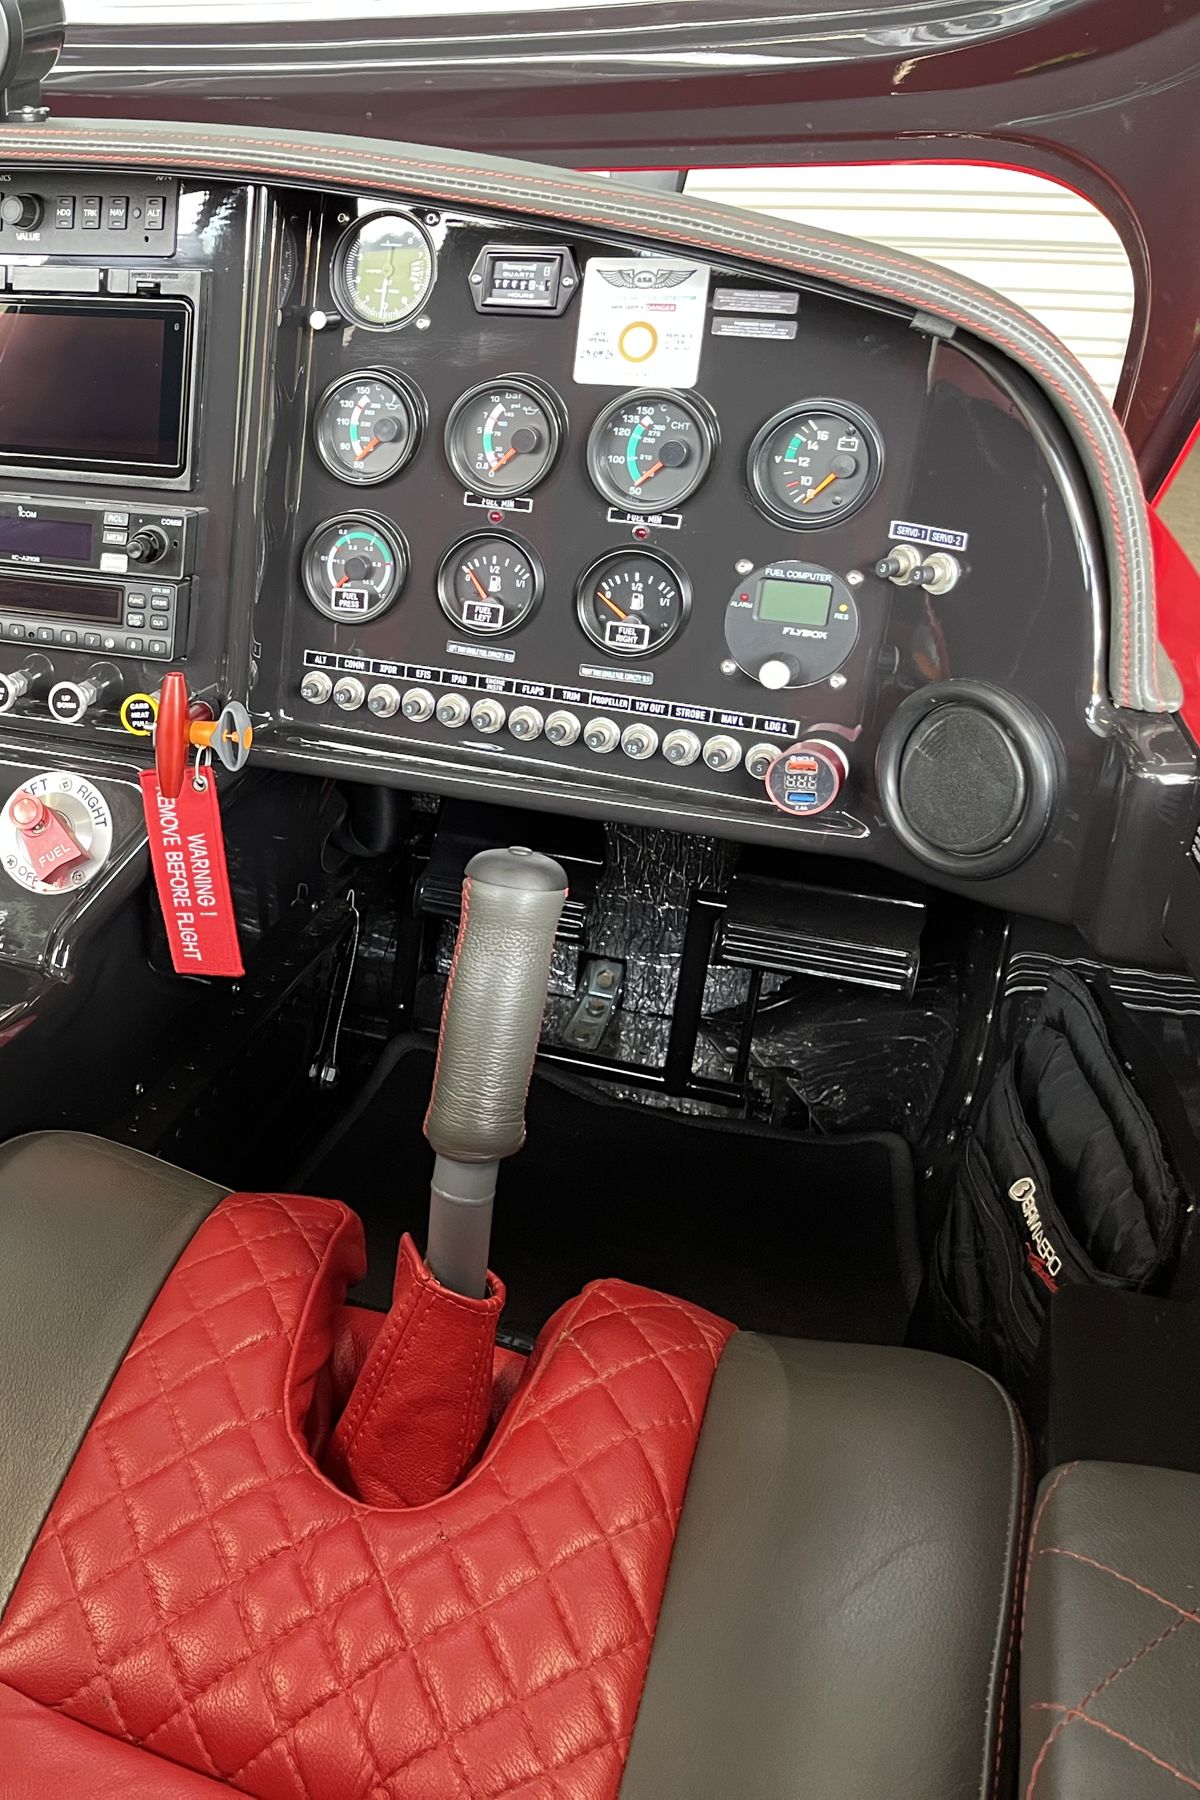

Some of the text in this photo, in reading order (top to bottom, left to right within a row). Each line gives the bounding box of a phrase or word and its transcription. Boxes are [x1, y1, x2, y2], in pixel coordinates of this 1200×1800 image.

[56, 208, 71, 217] HDG
[83, 208, 97, 217] TRK
[109, 208, 125, 217] NAV
[147, 208, 160, 217] ALT
[16, 233, 41, 242] VALUE
[356, 386, 371, 395] 150
[340, 399, 355, 408] 130
[490, 395, 500, 403] 10
[636, 406, 655, 416] 150
[336, 417, 350, 426] 110
[622, 415, 640, 423] 135
[671, 421, 691, 430] CHT
[613, 427, 631, 436] 120
[817, 430, 829, 440] 16
[340, 443, 351, 451] 90
[807, 441, 819, 451] 14
[607, 455, 625, 464] 100
[798, 457, 811, 467] 12
[476, 462, 489, 470] 0.8
[800, 476, 812, 486] 10
[629, 486, 642, 495] 50
[482, 498, 515, 508] FUEL MIN
[108, 514, 123, 523] RCL
[161, 518, 183, 527] COMM
[626, 513, 663, 524] FUEL MIN
[106, 533, 124, 542] MEM
[896, 526, 926, 540] SERVO-1
[931, 532, 961, 546] SERVO-2
[490, 565, 500, 574] 1/2
[765, 567, 832, 582] FUEL COMPUTER
[631, 582, 643, 591] 1/2
[342, 592, 358, 601] FUEL
[339, 600, 360, 608] PRESS
[730, 601, 753, 609] ALARM
[474, 606, 491, 615] FUEL
[474, 614, 492, 623] LEFT
[618, 627, 636, 636] FUEL
[782, 626, 828, 640] FLYBOX
[616, 634, 639, 644] RIGHT
[315, 655, 327, 665] ALT
[344, 660, 365, 670] COMM
[380, 664, 398, 675] XPDR
[415, 669, 432, 680] EFIS
[451, 674, 468, 685] IPAD
[522, 684, 545, 696] FLAPS
[562, 690, 581, 702] TRIM
[592, 693, 628, 708] PROPELLER
[635, 701, 648, 712] 12V
[650, 703, 666, 714] OUT
[675, 707, 706, 720] STROBE
[721, 713, 739, 725] NAV
[764, 720, 780, 731] LDG
[56, 701, 77, 709] DOWN
[130, 702, 150, 710] CARB
[131, 710, 150, 719] HEAT
[302, 688, 637, 753] 25 10 15
[76, 784, 108, 828] RIGHT
[38, 844, 71, 868] FUEL
[186, 832, 216, 907] WARNING
[18, 865, 39, 887] OFF
[165, 851, 192, 907] BEFORE
[176, 912, 202, 961] FLIGHT
[1021, 1197, 1063, 1277] BRMAERO
